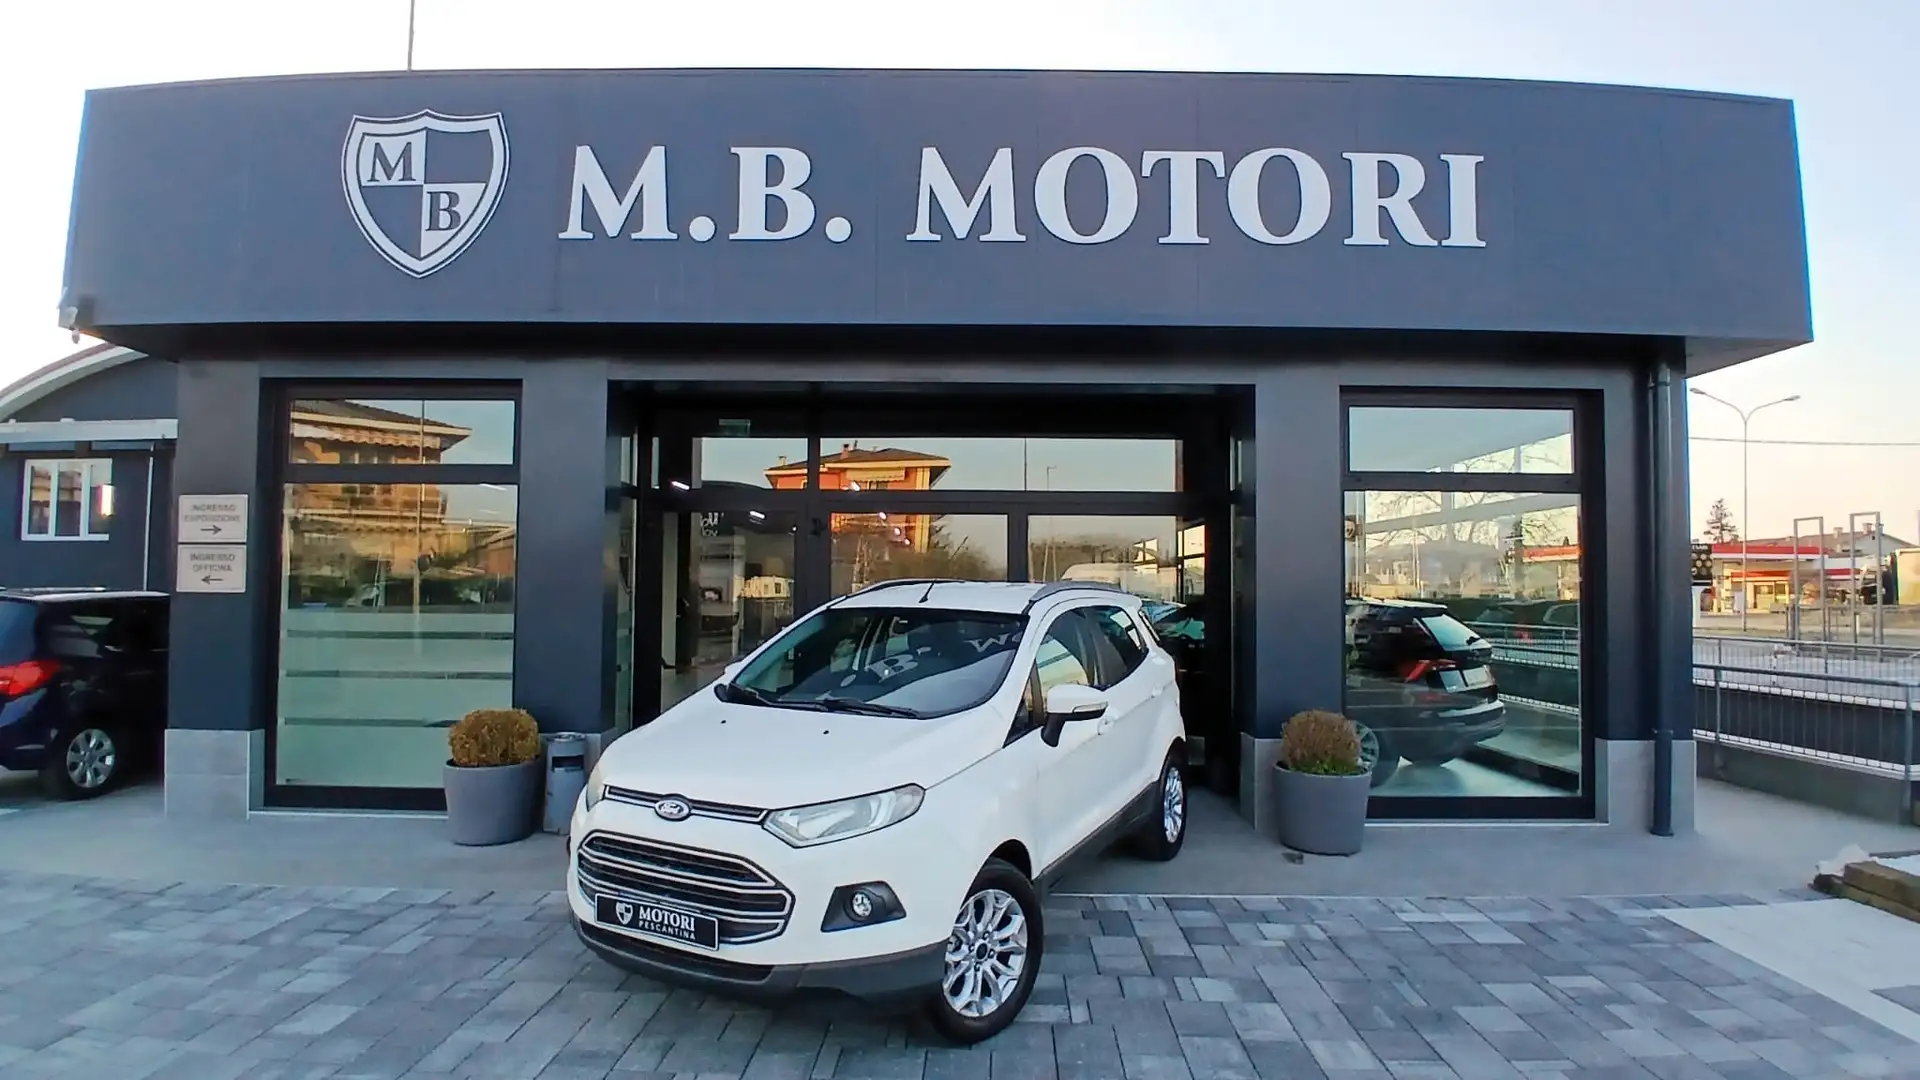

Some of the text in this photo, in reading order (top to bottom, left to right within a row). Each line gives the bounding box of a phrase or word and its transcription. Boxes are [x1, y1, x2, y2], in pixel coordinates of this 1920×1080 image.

[367, 141, 416, 182] M
[425, 191, 461, 231] B
[558, 145, 1487, 248] M.B. MOTORI
[638, 905, 696, 932] MOTORI
[638, 920, 697, 940] PESCANTINA
